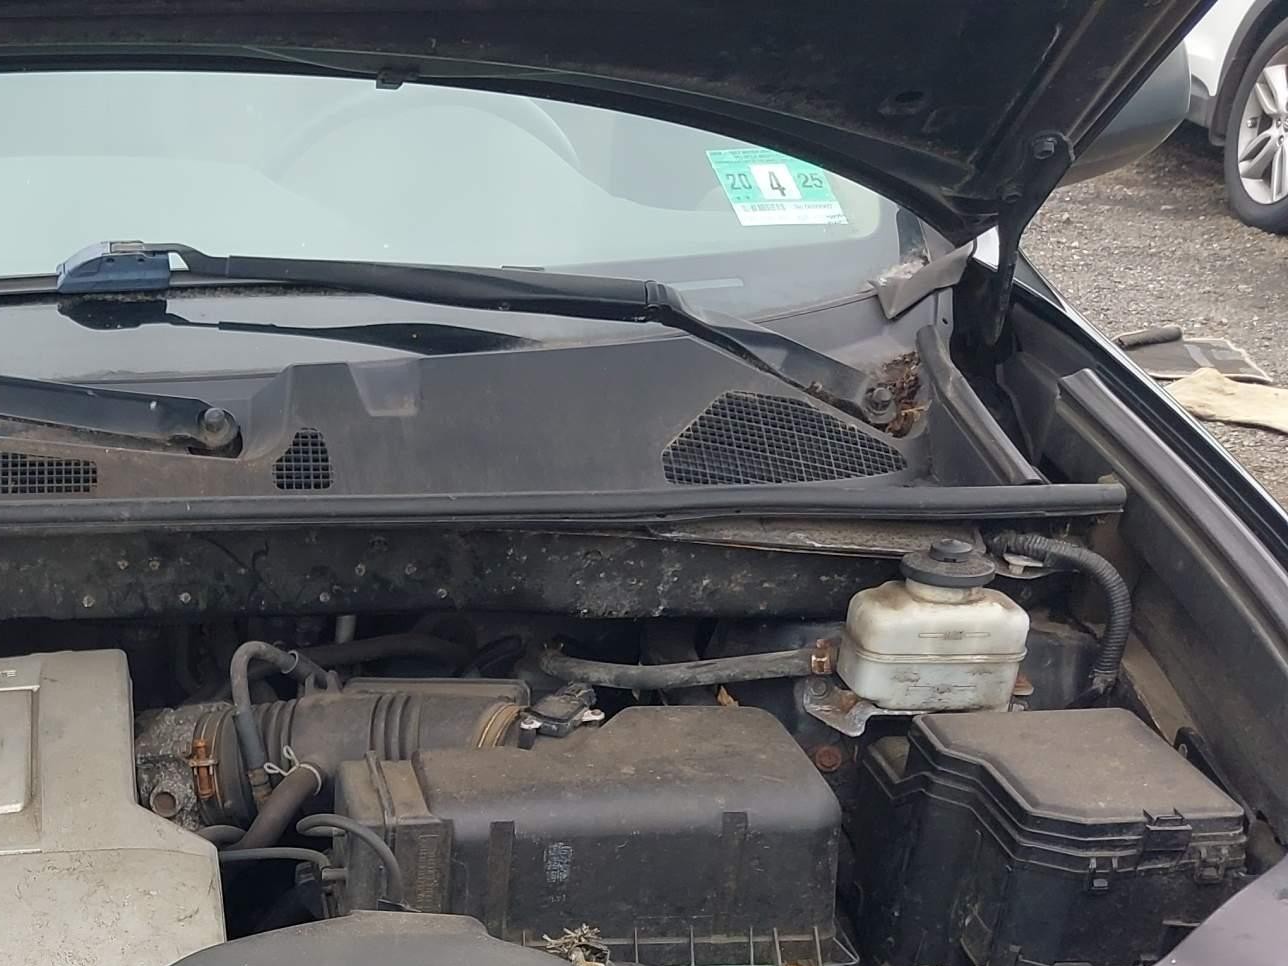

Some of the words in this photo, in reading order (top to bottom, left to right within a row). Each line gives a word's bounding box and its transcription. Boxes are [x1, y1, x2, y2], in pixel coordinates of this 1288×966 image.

[726, 173, 753, 190] 20
[769, 171, 787, 197] 4
[797, 172, 823, 189] 25
